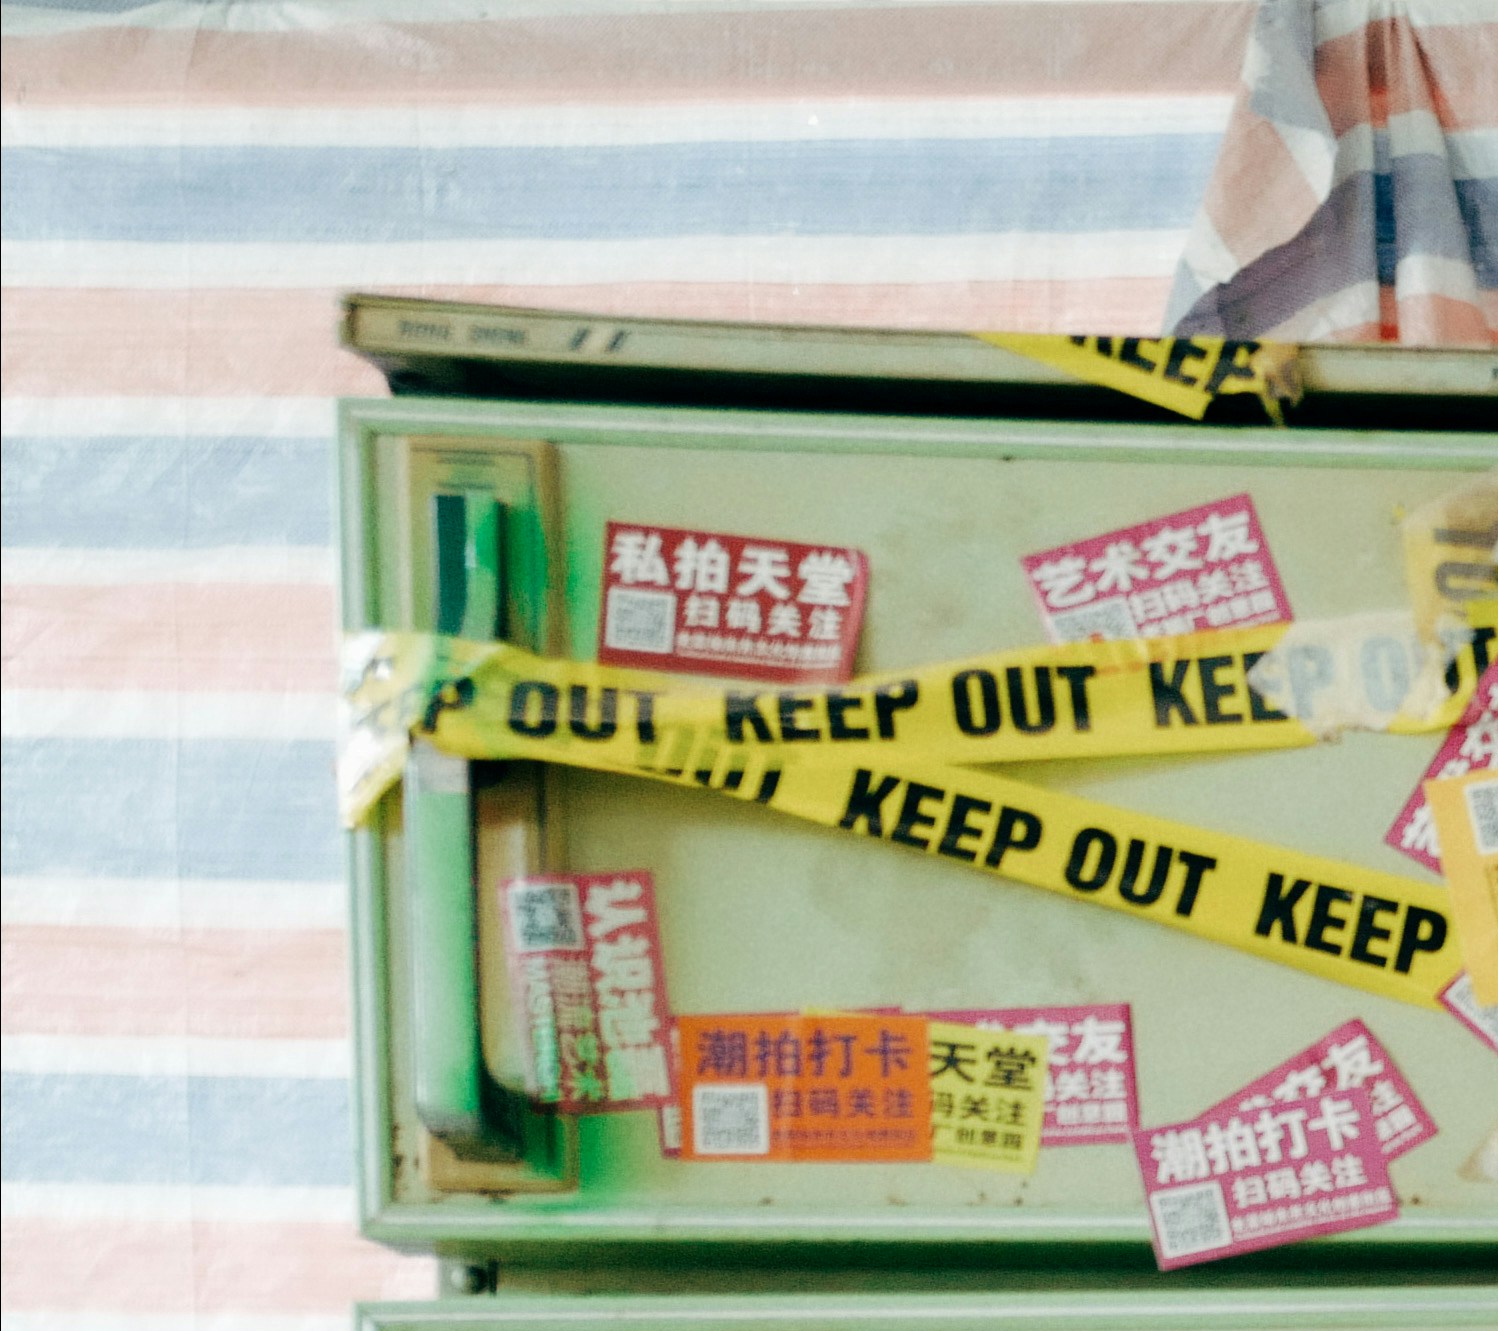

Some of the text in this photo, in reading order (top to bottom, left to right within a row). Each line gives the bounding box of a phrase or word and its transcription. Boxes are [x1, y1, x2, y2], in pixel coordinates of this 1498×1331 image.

[1069, 336, 1262, 392] EEP
[610, 530, 853, 606] 私拍天堂
[1032, 510, 1259, 607] 艺术交友
[683, 595, 842, 640] 扫码关注
[1129, 559, 1272, 625] 扫码关注
[507, 681, 660, 744] OUT
[724, 680, 922, 744] KEEP
[952, 665, 1097, 737] OUT
[838, 768, 1042, 870] KEEP
[1063, 826, 1217, 919] OUT
[1254, 872, 1449, 976] KEEP
[696, 1028, 912, 1078] 潮拍打卡
[930, 1040, 1037, 1091] 天堂
[772, 1087, 914, 1121] 扫码关注
[932, 1091, 1024, 1126] 码关注
[1049, 1070, 1126, 1099] 关注
[1150, 1097, 1361, 1184] 潮拍打卡
[1232, 1153, 1369, 1208] 扫码关注
